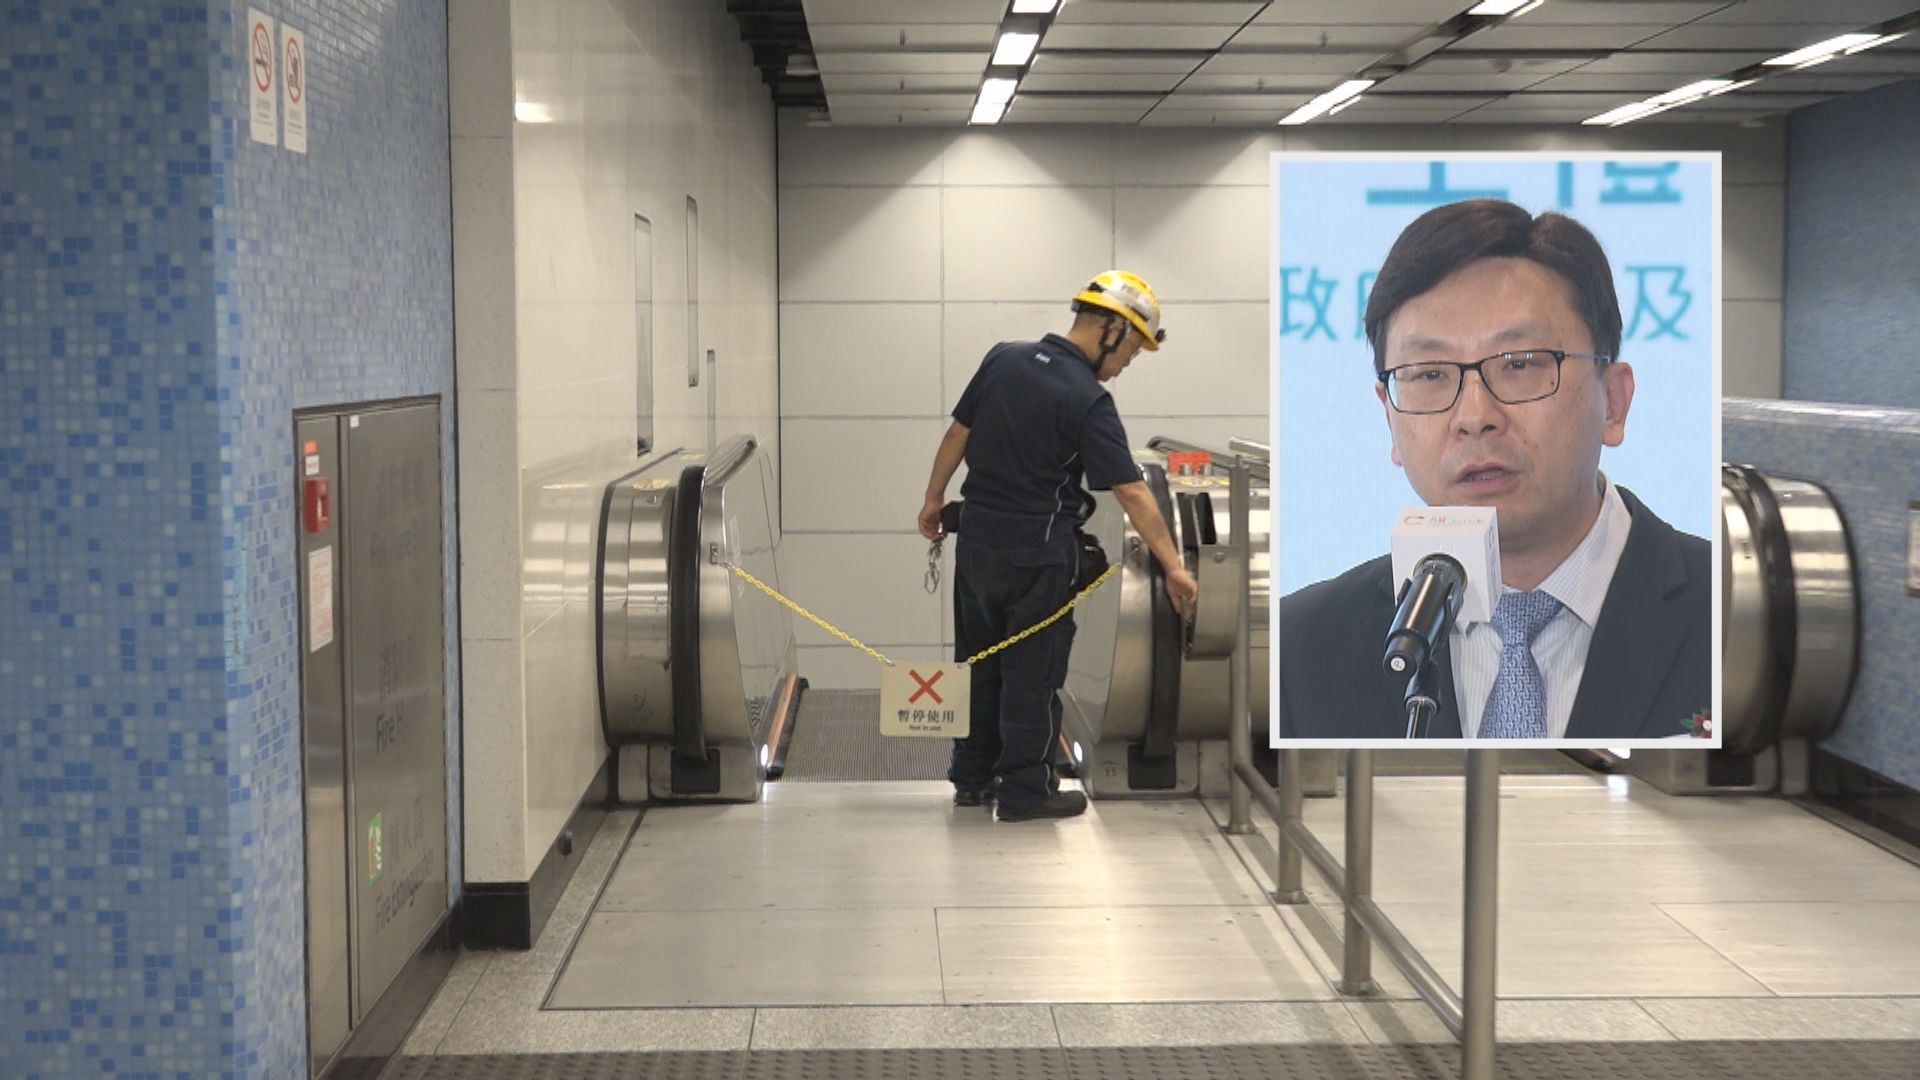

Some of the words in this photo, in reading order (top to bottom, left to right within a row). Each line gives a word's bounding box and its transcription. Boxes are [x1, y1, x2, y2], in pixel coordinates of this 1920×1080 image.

[1280, 265, 1376, 341] 政
[1622, 266, 1693, 341] 及
[376, 714, 395, 756] Fire
[898, 709, 954, 723] 暫停使用
